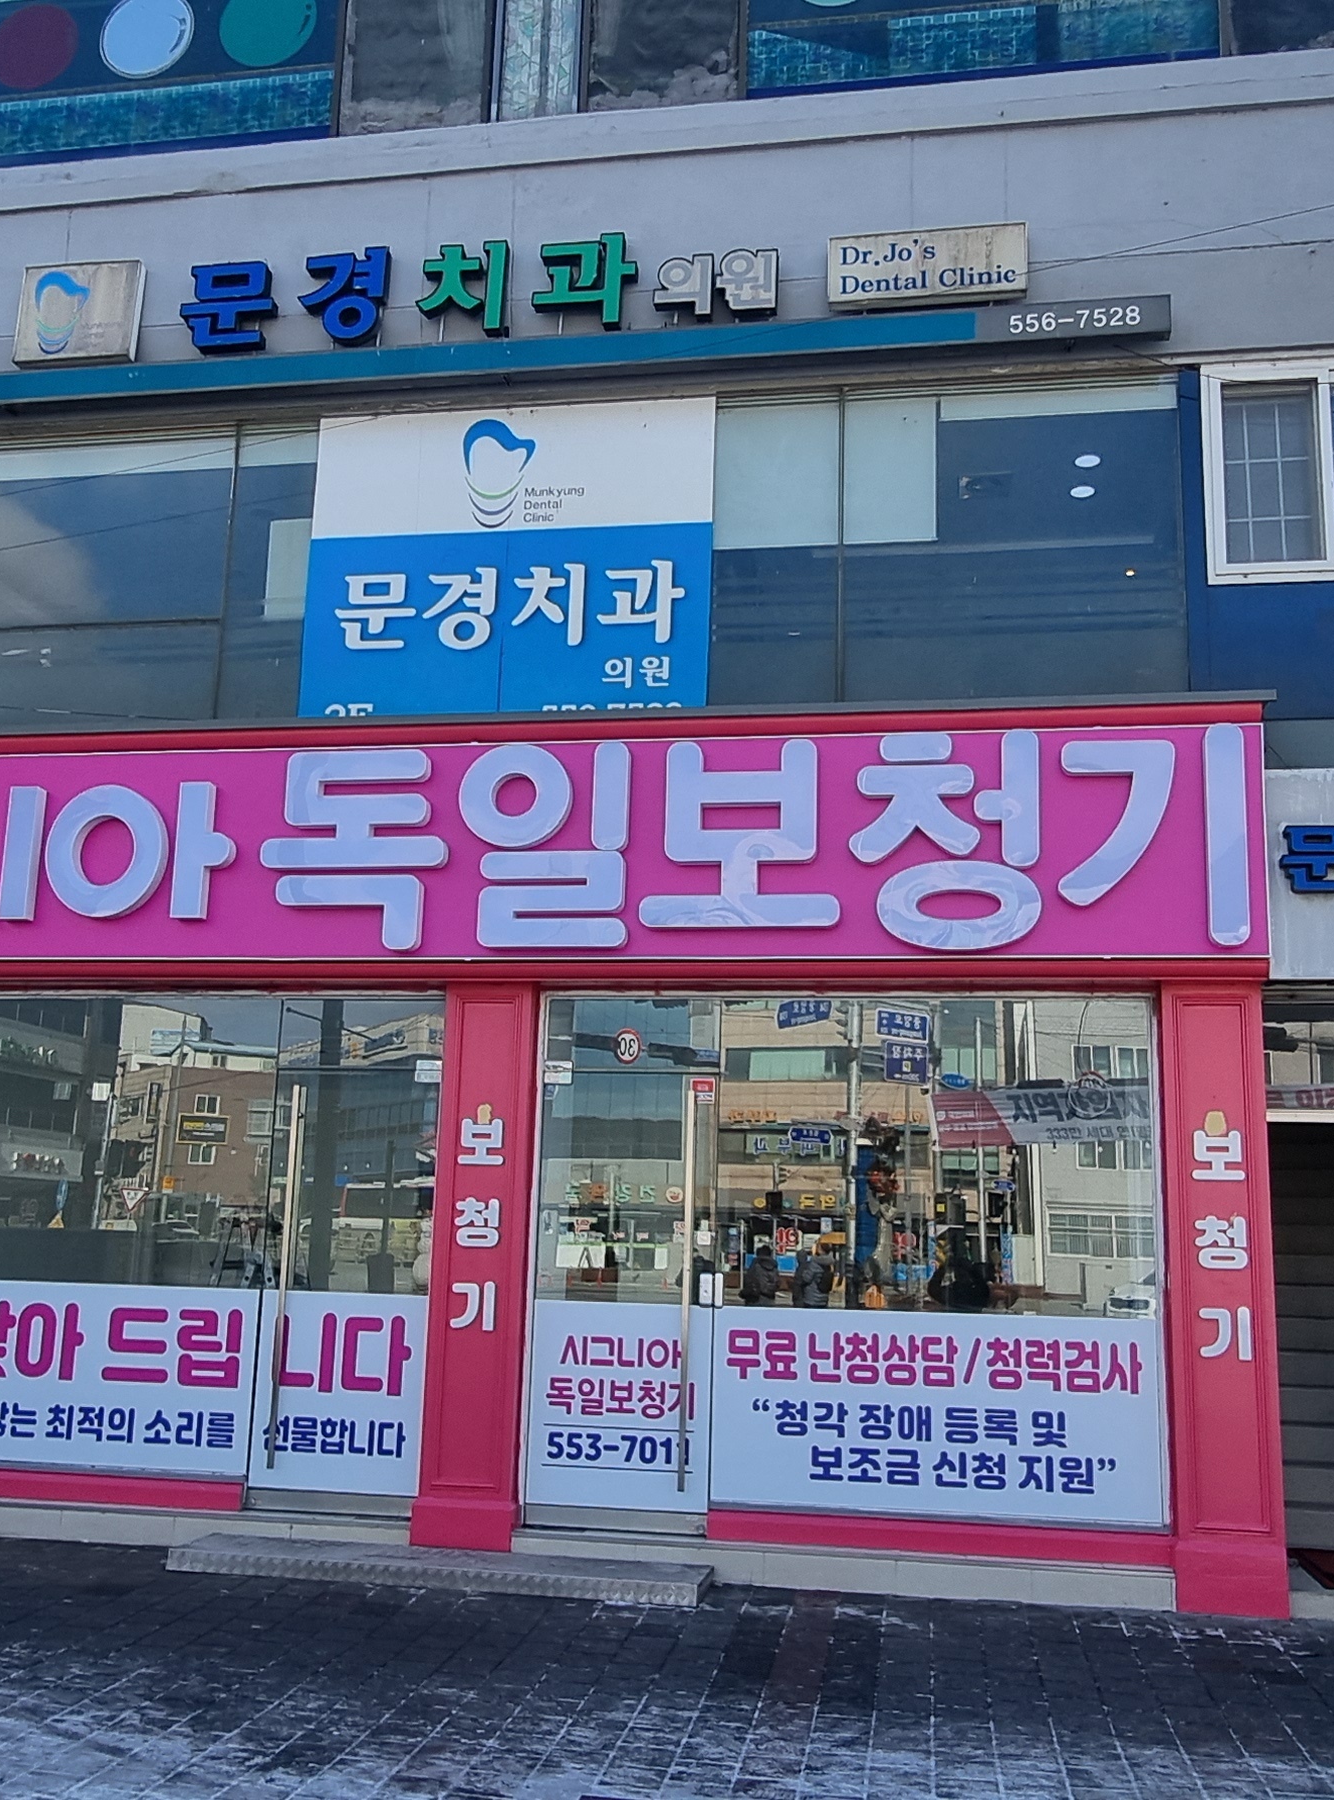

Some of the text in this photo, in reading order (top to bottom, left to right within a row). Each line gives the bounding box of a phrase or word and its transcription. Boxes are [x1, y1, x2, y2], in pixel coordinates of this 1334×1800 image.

[652, 247, 780, 316] 의원
[840, 263, 1017, 295] Dental Clinic
[1008, 305, 1142, 334] 556-7528
[523, 499, 563, 511] Dental
[524, 485, 586, 498] Munkyung
[523, 511, 555, 524] Clinic
[334, 559, 686, 650] 문경치과
[602, 656, 671, 689] 의원
[259, 723, 1251, 952] 독일보청기
[449, 1117, 505, 1332] 보청기
[1191, 1129, 1252, 1362] 보청기
[559, 1335, 682, 1370] 시그니아
[726, 1328, 798, 1381] 무료
[545, 1376, 695, 1421] 독일보청기
[44, 1404, 136, 1444] 최적의
[142, 1409, 235, 1450] 소리를
[262, 1415, 407, 1459] 선물합니다
[546, 1431, 690, 1466] 553-7011
[858, 1402, 933, 1443] 장애
[943, 1406, 1019, 1447] 등록
[1031, 1410, 1068, 1449] 및
[808, 1444, 921, 1487] 보조금
[932, 1450, 1007, 1491] 신청
